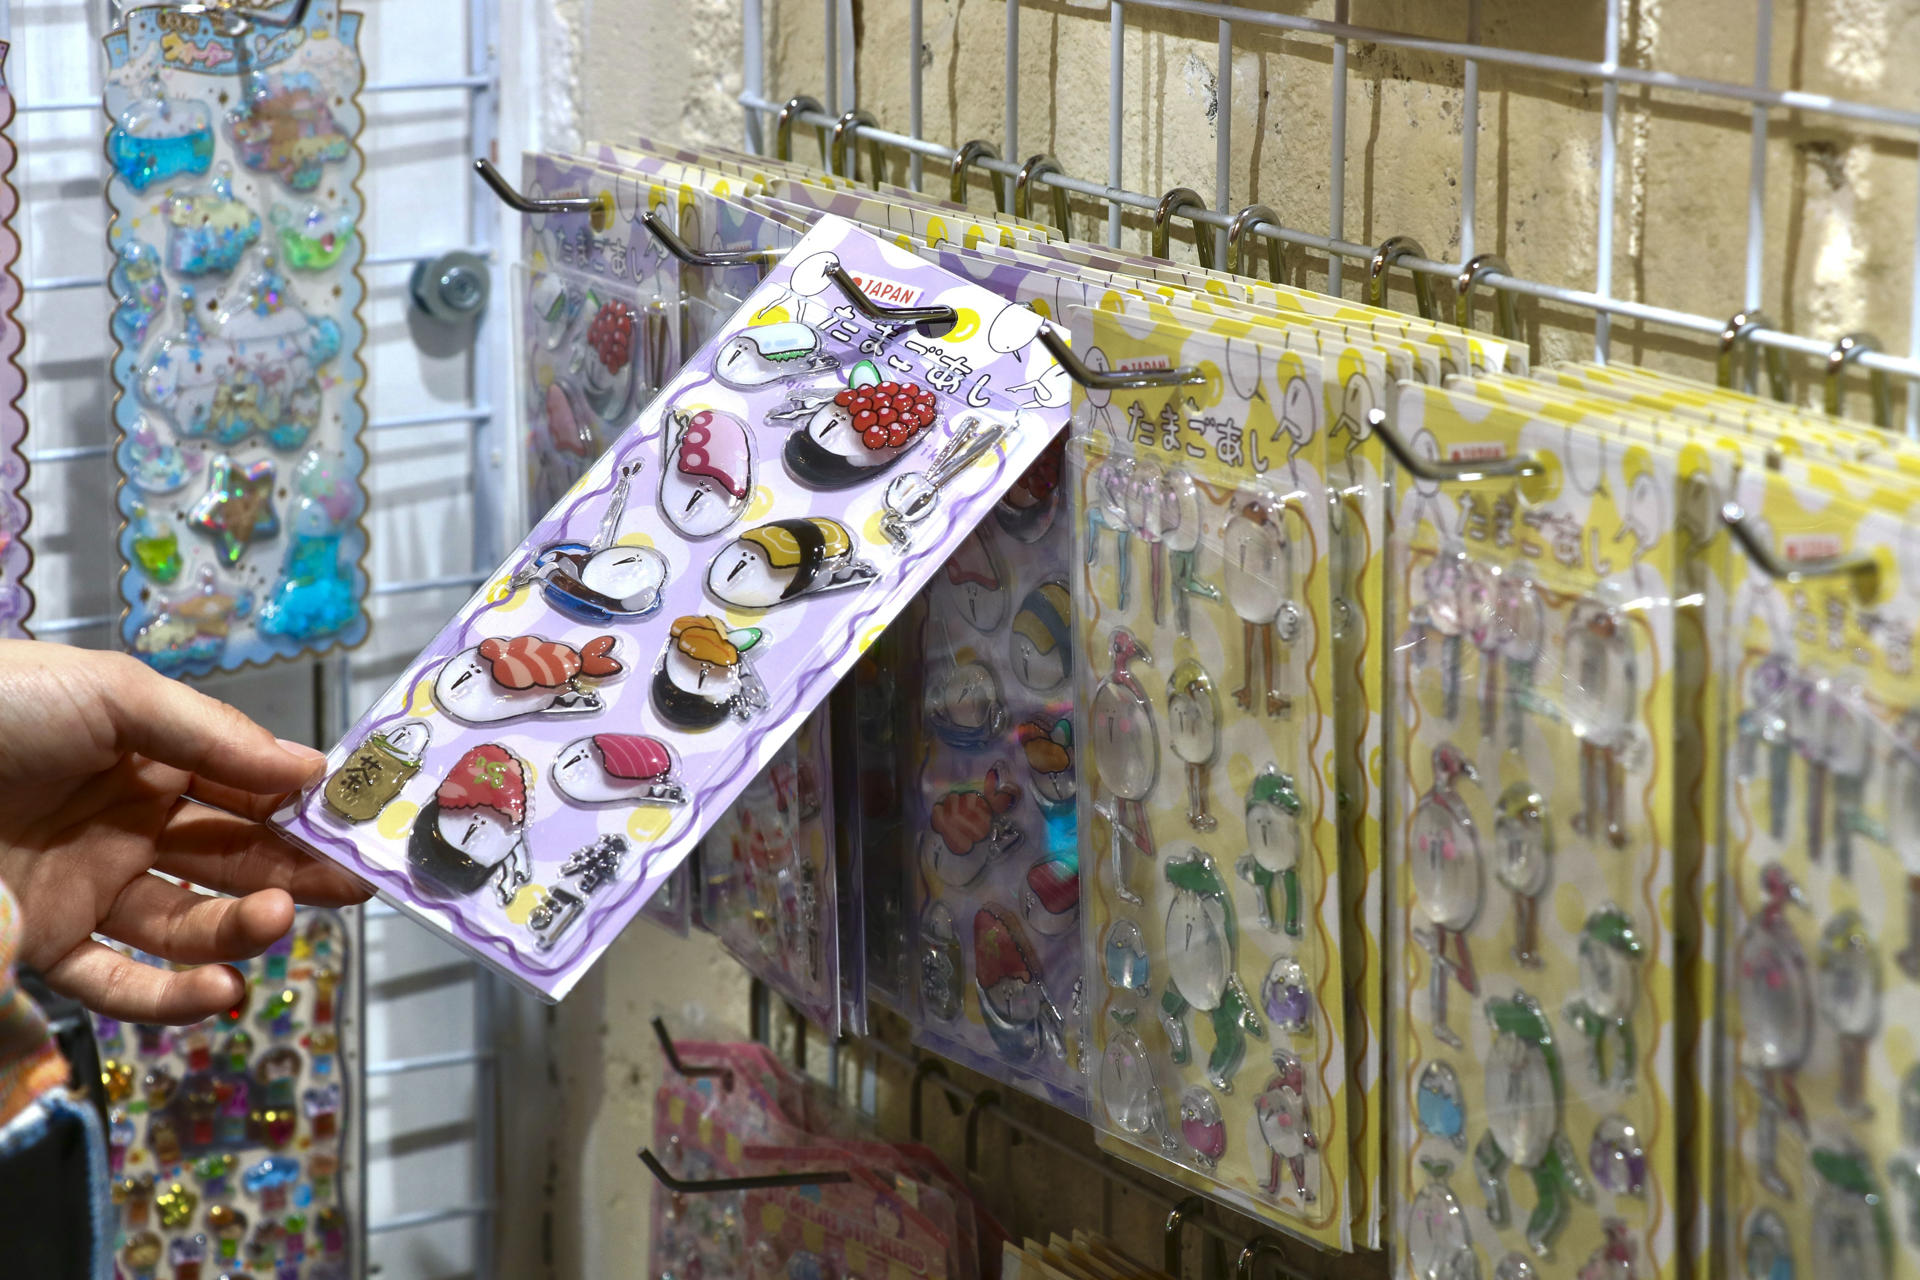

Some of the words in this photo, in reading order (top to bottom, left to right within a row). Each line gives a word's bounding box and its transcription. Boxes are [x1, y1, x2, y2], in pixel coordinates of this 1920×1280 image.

[864, 280, 914, 304] JAPAN
[815, 304, 991, 408] たまごあし
[1126, 400, 1269, 473] たまごあし
